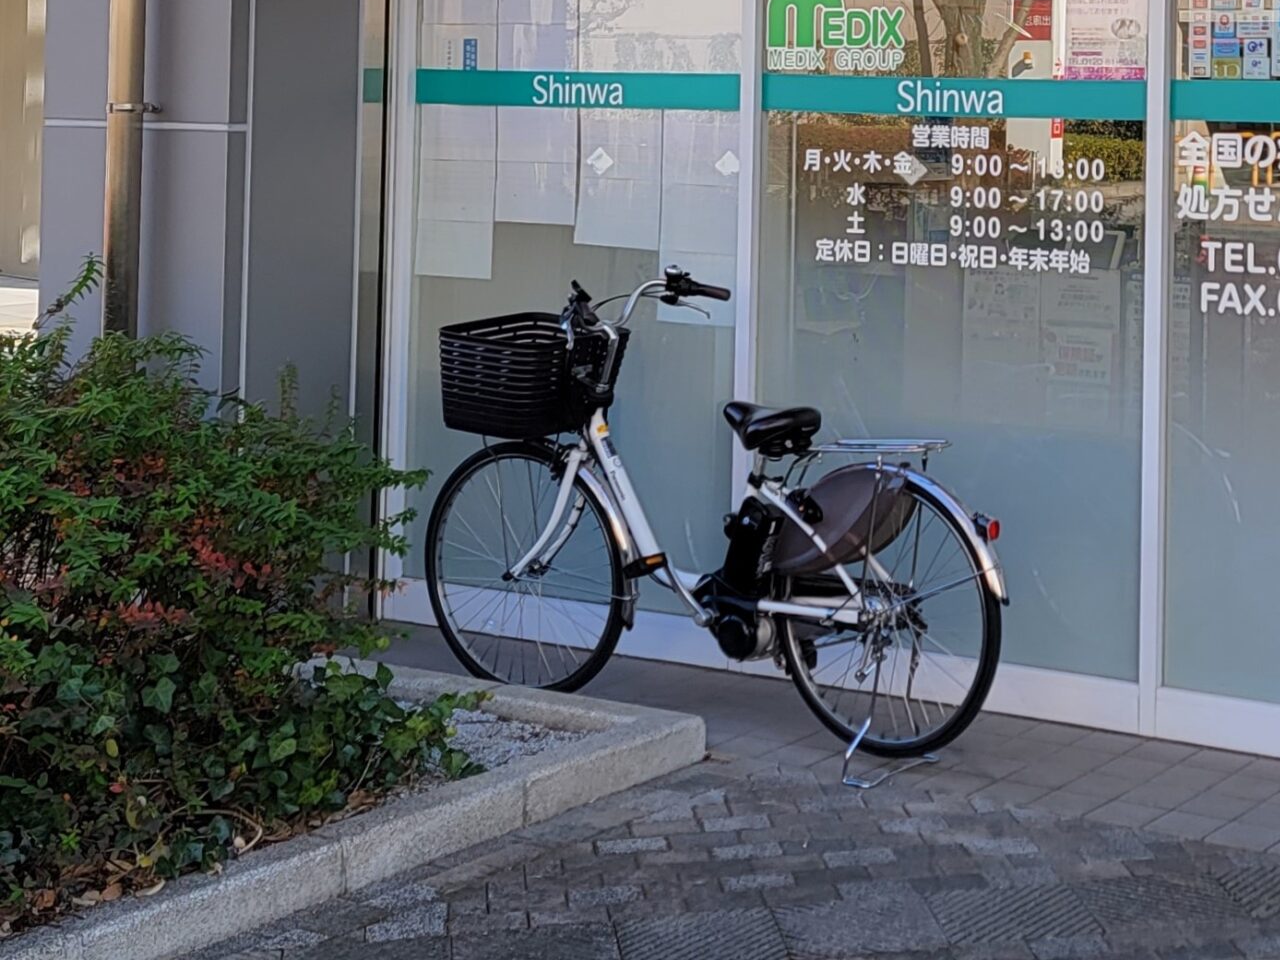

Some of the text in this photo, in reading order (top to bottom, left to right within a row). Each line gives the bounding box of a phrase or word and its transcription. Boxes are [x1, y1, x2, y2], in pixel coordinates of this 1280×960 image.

[767, 48, 905, 70] MEDIX GROUP
[531, 75, 624, 106] Shinwa
[897, 80, 1004, 115] Shinwa
[911, 125, 990, 150] 営業時間
[846, 183, 866, 206] 水
[846, 213, 866, 234] 土
